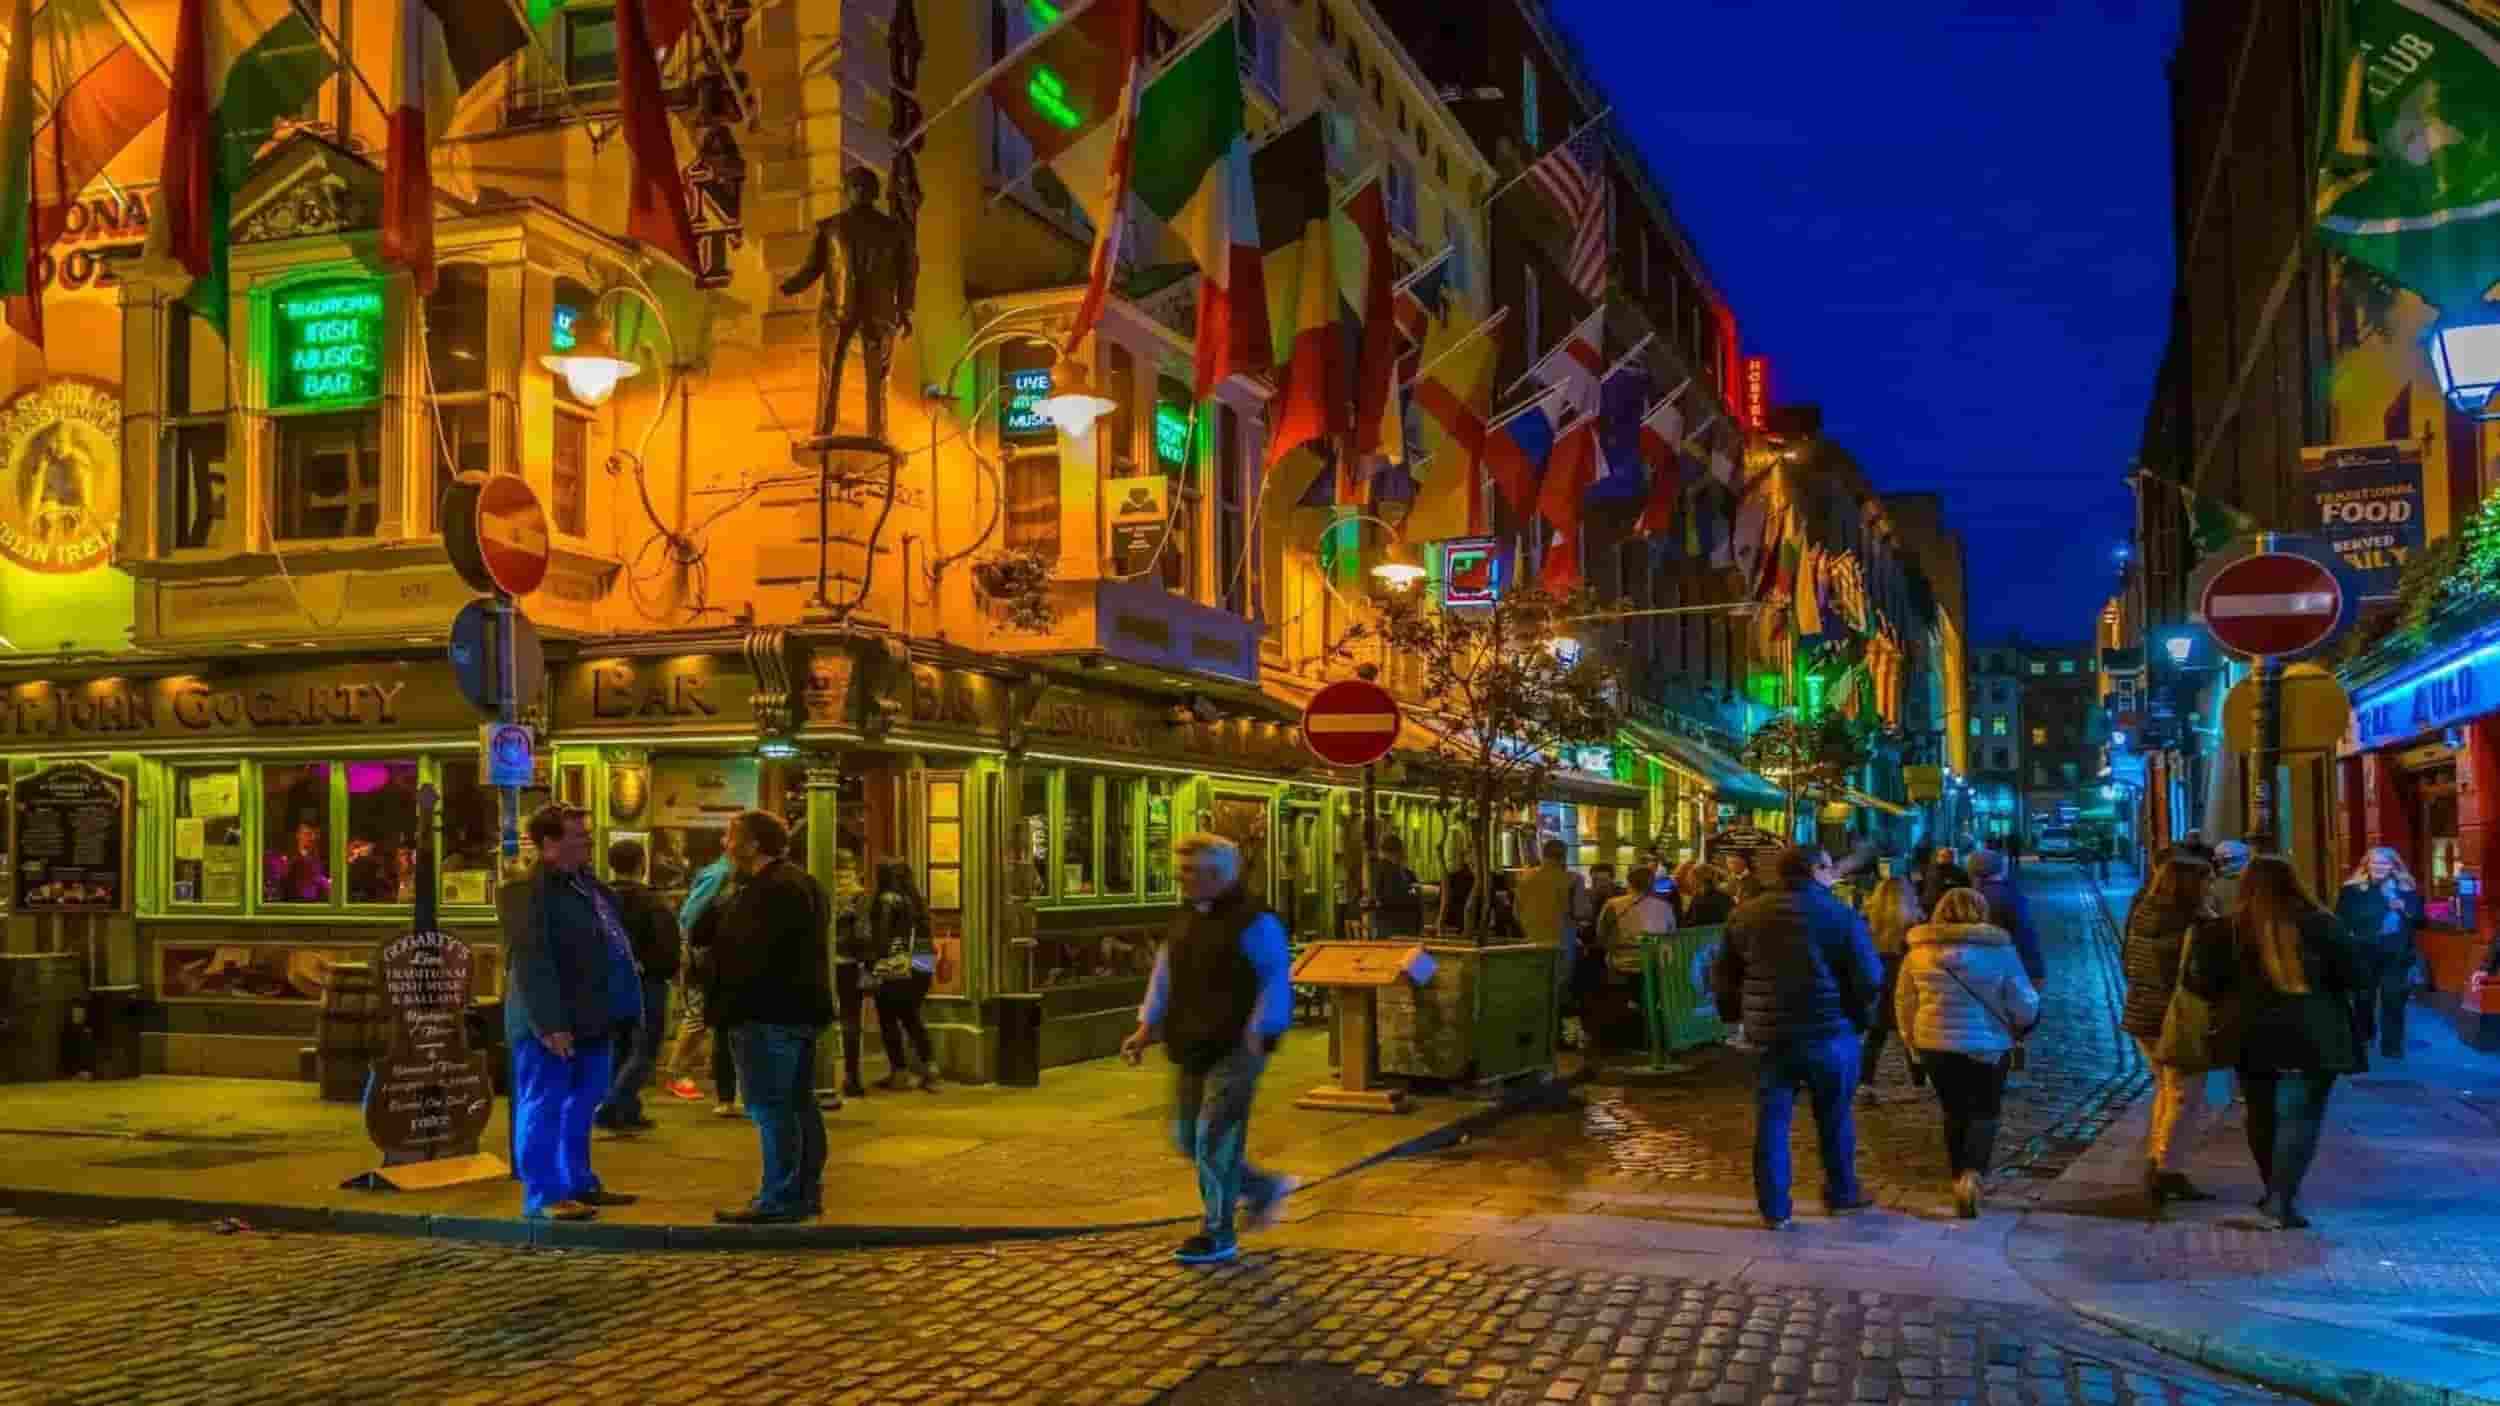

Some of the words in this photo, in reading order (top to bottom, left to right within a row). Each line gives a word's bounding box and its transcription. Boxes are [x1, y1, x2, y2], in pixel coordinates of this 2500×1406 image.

[2367, 33, 2433, 103] CLUB
[304, 320, 359, 342] IRISH
[293, 346, 367, 371] MUSIC
[304, 374, 354, 397] BAR
[1015, 374, 1050, 390] LIVE
[1748, 359, 1762, 428] HOSTEL
[2321, 500, 2412, 524] FOOD
[2334, 534, 2395, 555] SERVED
[172, 680, 406, 730] GOGARTY
[591, 667, 719, 718] BAR
[2412, 667, 2473, 724] AULD
